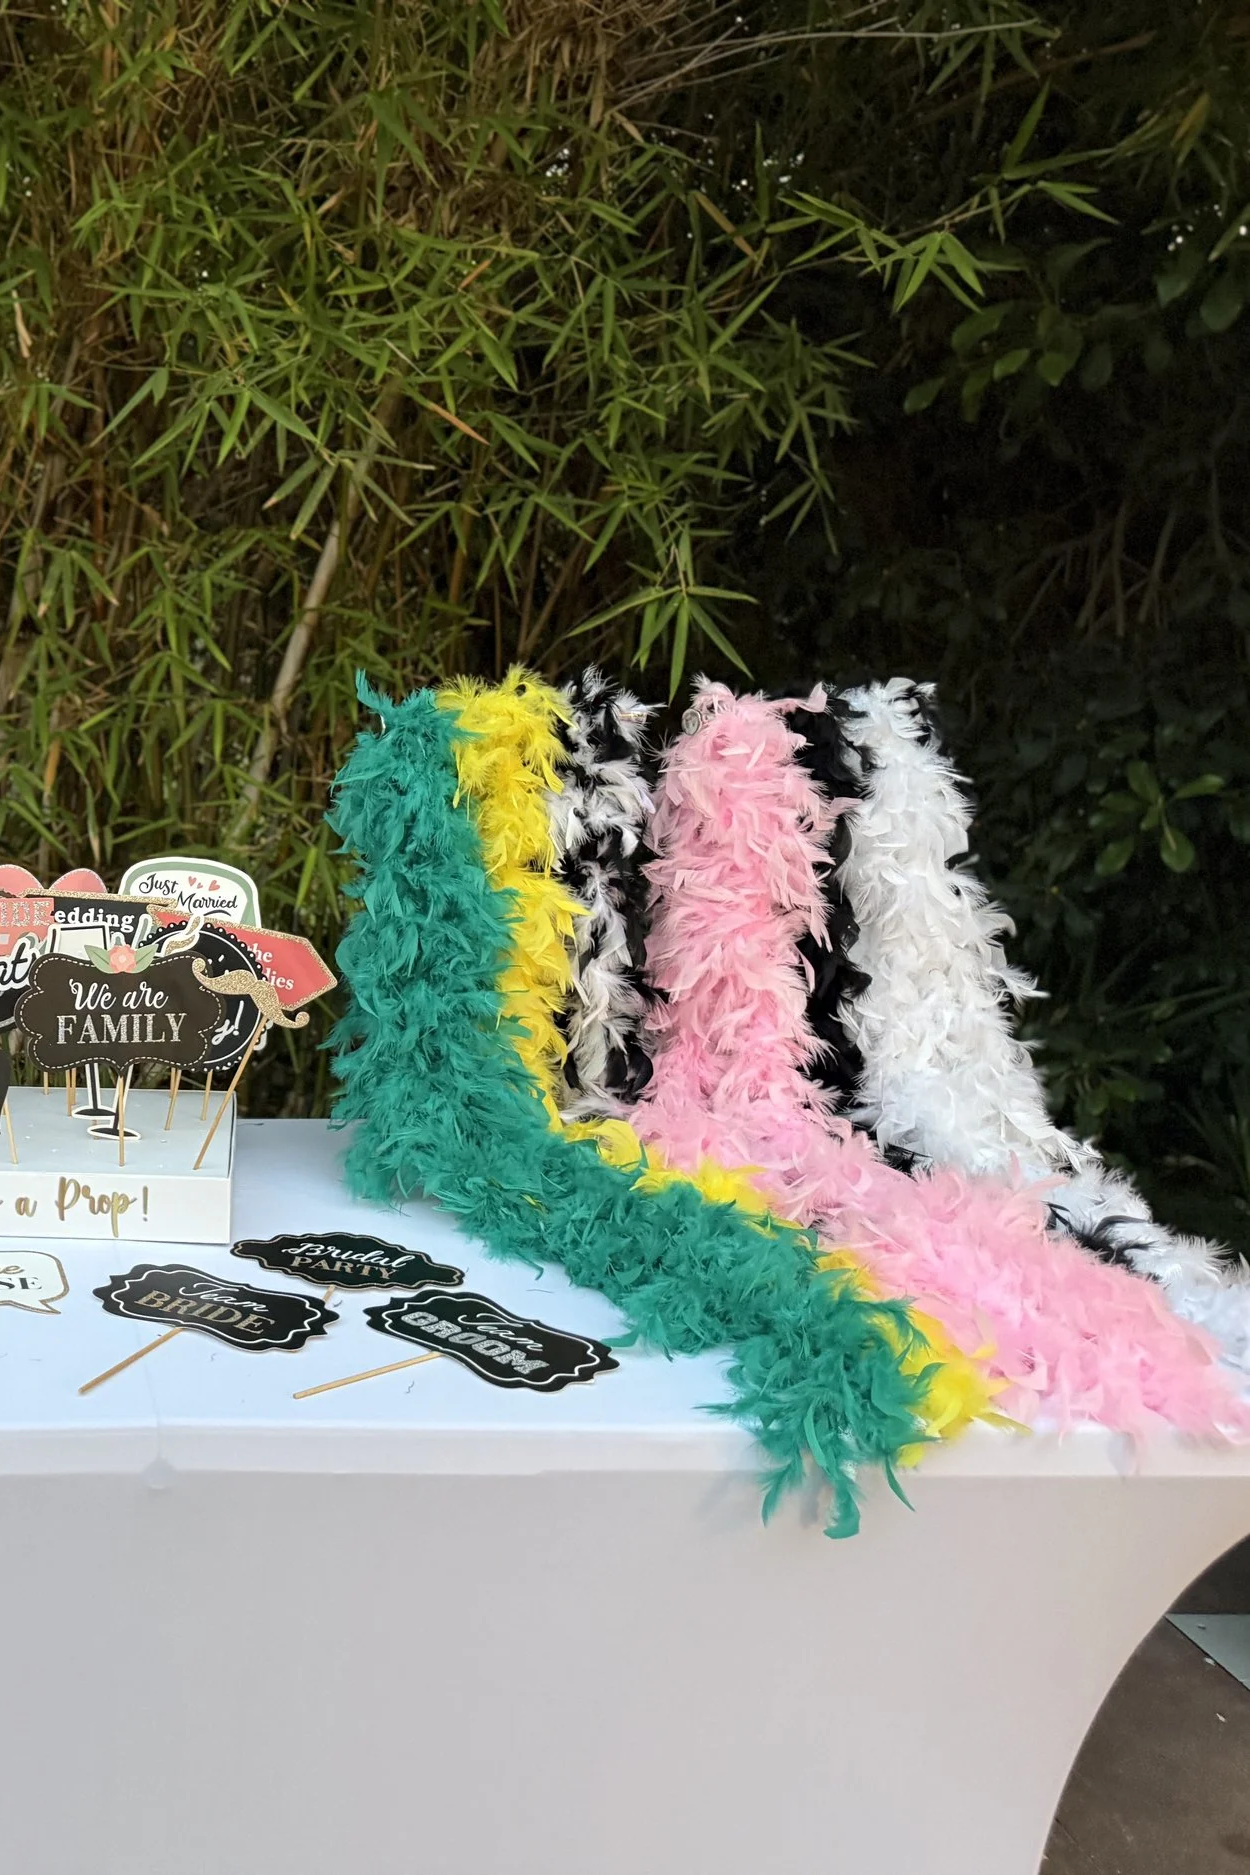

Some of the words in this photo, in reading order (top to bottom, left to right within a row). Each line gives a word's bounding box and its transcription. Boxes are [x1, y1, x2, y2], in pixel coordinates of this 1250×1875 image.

[139, 873, 179, 896] Just
[177, 890, 238, 912] Married
[53, 906, 135, 933] edding
[247, 943, 273, 963] he
[69, 978, 117, 1011] We
[122, 981, 169, 1010] are
[56, 1012, 187, 1045] FAMILY
[14, 1196, 38, 1218] a
[281, 1242, 415, 1268] Bridal
[290, 1256, 398, 1280] PARTY
[179, 1282, 269, 1312] Team
[134, 1289, 275, 1334] BRIDE
[401, 1311, 550, 1375] GROOM
[457, 1313, 544, 1351] Team
